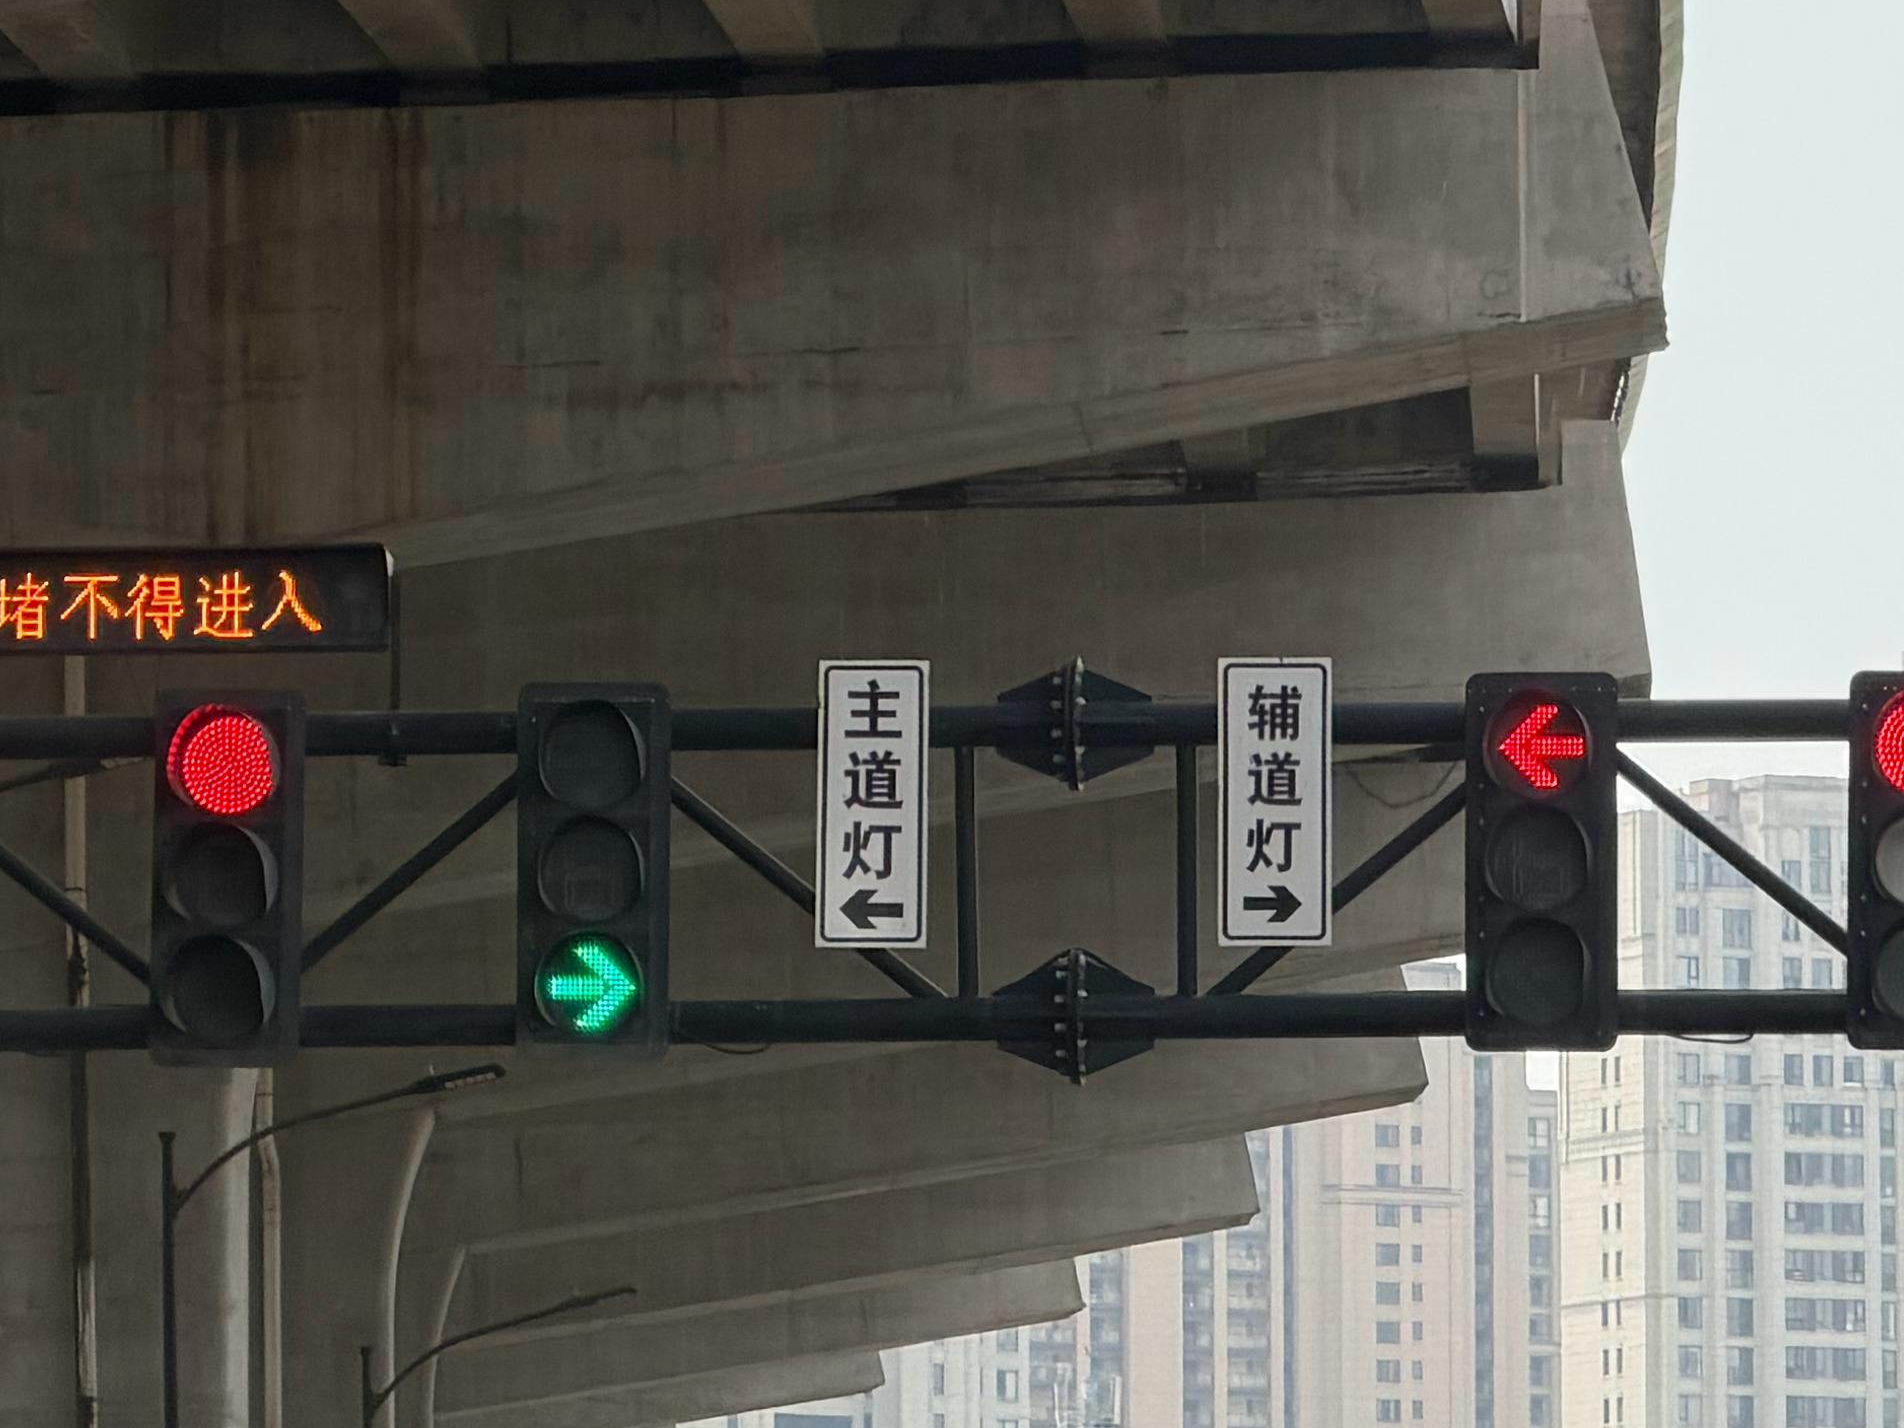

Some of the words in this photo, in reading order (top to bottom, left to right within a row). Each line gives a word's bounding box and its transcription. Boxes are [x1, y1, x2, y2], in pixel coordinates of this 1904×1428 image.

[843, 679, 903, 880] 主道灯
[1245, 684, 1303, 873] 辅道灯
